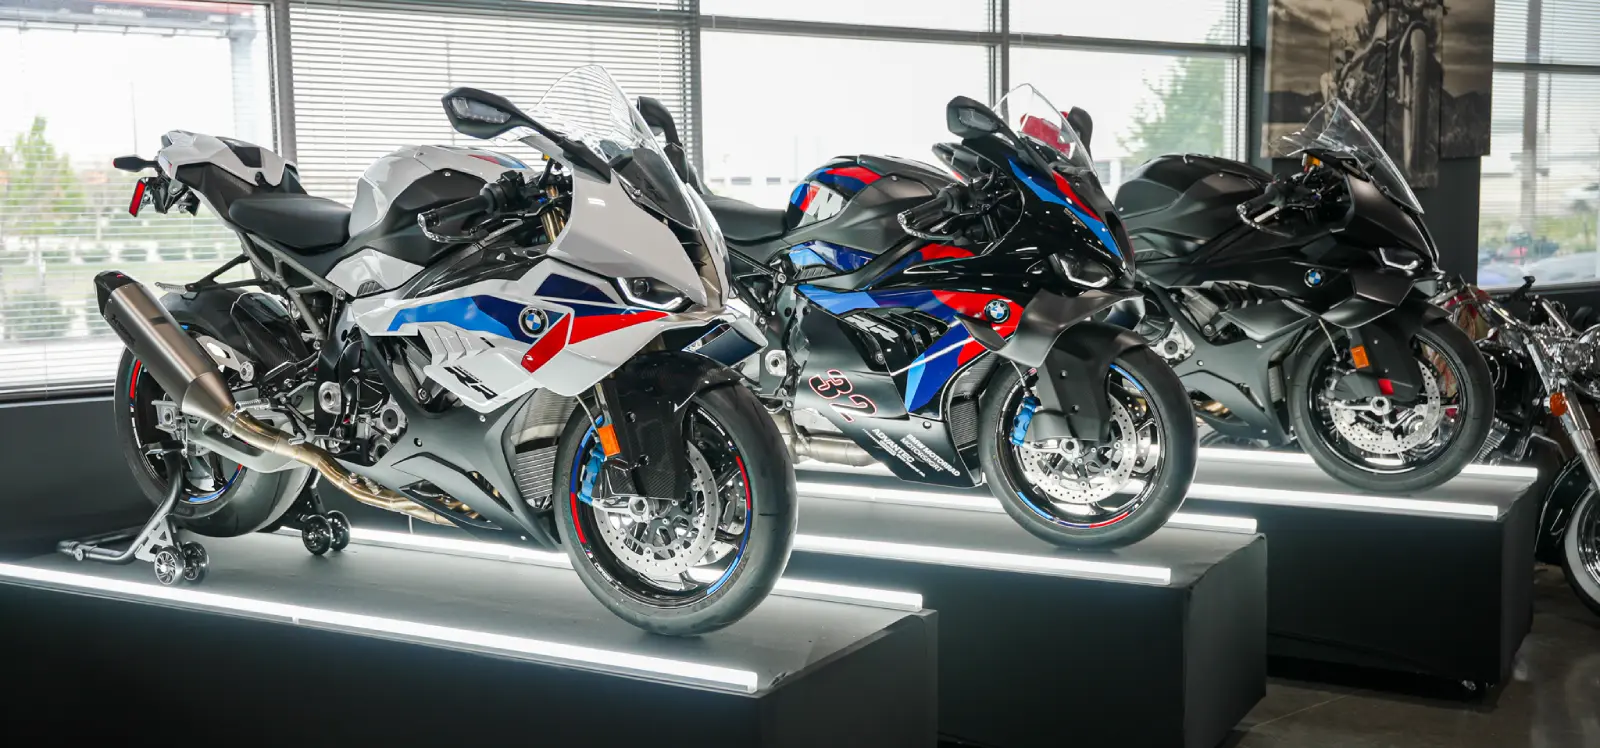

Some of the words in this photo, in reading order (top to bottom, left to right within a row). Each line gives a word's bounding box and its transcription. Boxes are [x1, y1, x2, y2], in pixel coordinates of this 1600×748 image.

[844, 314, 899, 343] RR
[808, 369, 877, 422] 32
[872, 428, 915, 463] ADVANTEC
[900, 437, 944, 472] MOTORSPORT
[906, 433, 924, 451] BMW
[922, 445, 961, 477] MOTORRAD
